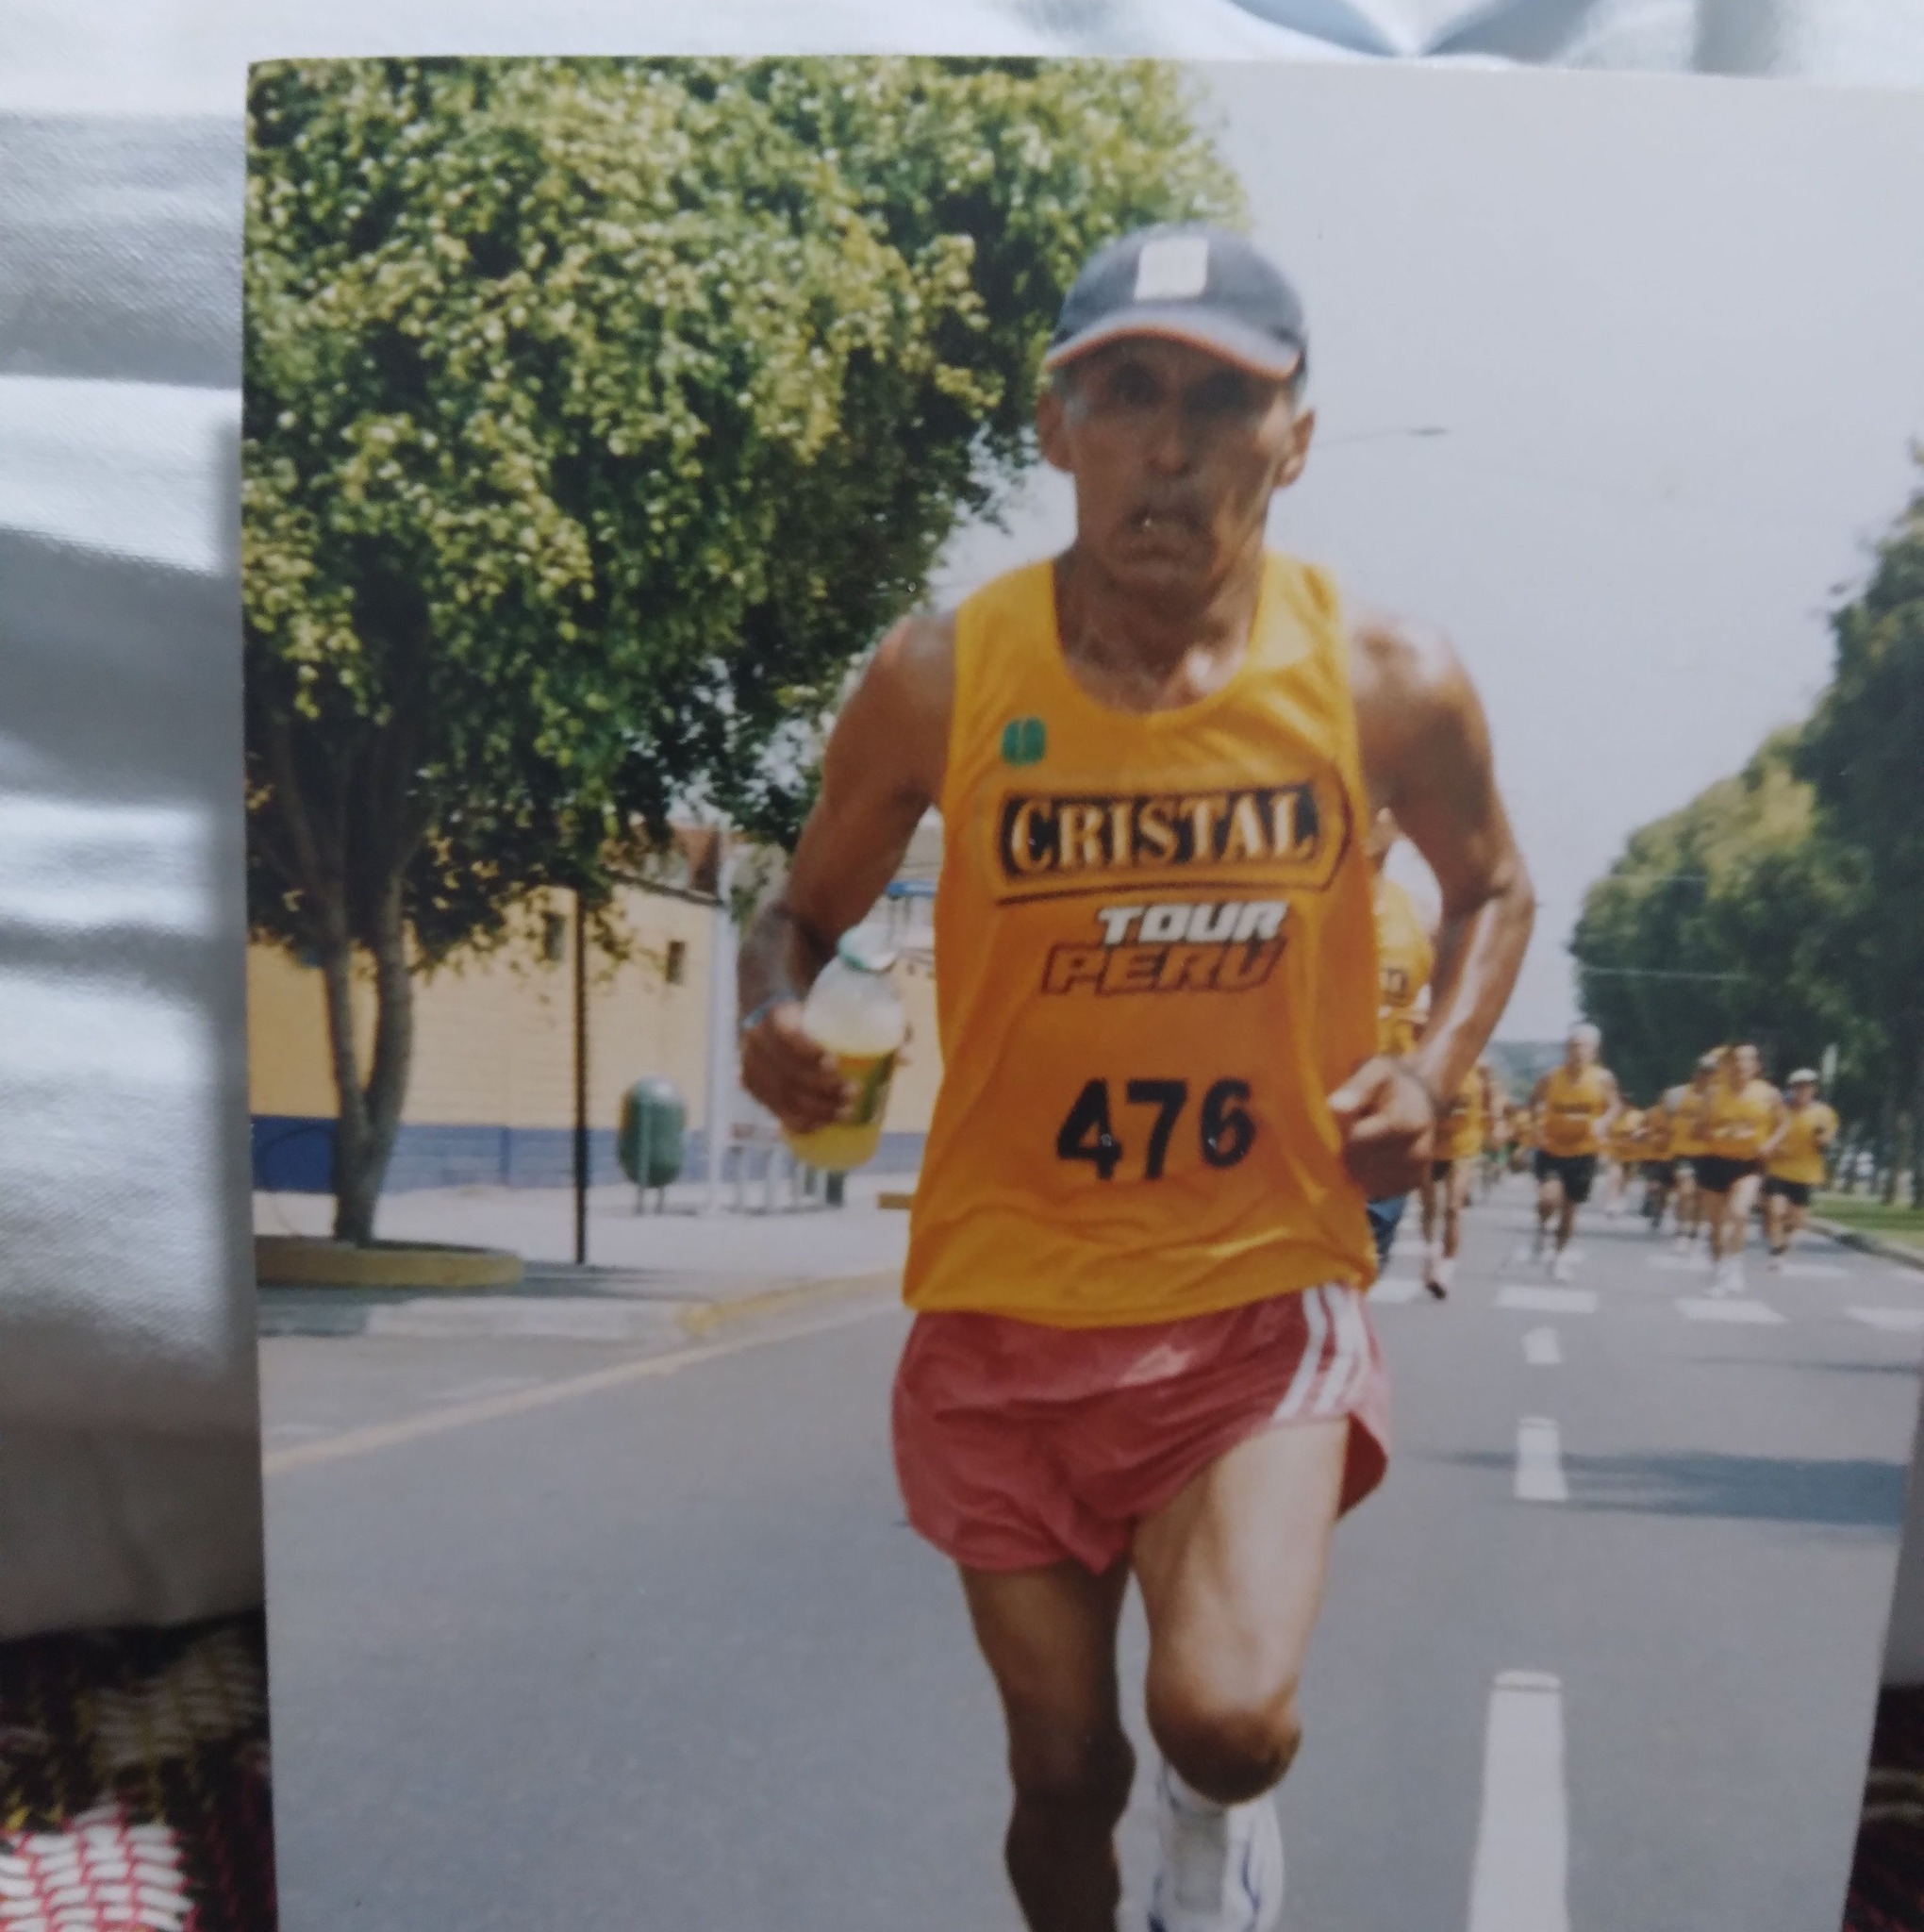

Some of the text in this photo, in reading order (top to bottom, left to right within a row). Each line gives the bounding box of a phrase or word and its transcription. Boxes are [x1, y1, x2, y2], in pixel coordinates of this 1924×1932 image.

[1011, 791, 1314, 872] CRISTAL
[1098, 900, 1288, 946] TOUR
[1042, 941, 1285, 995] PERU
[1055, 1078, 1256, 1181] 476
